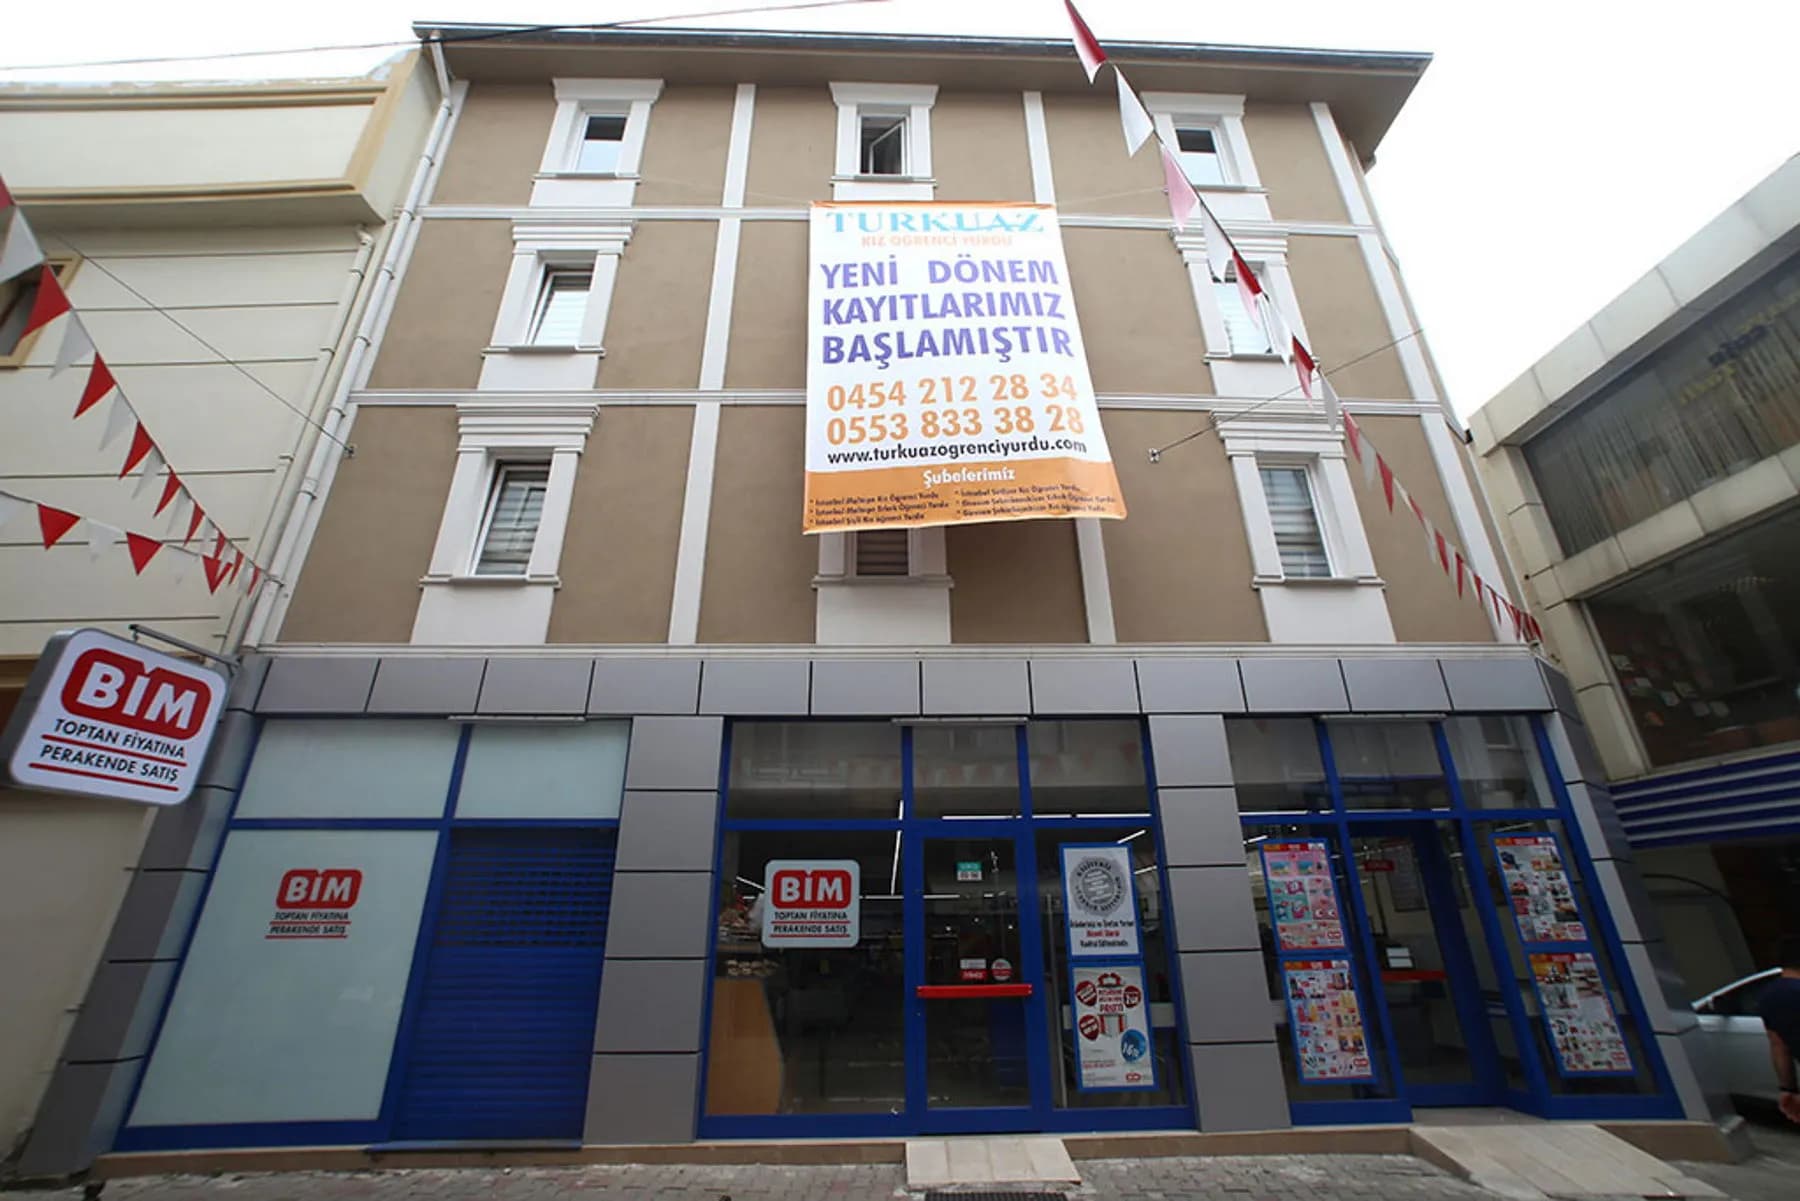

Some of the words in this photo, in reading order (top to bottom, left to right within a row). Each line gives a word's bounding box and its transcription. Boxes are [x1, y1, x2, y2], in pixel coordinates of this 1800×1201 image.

[827, 212, 1044, 233] TURKUAZ
[820, 254, 899, 289] YENİ
[927, 253, 1059, 285] DÖNEM
[823, 291, 1066, 325] KAYITLARIMIZ
[822, 326, 1075, 370] BAŞLAMIŞTIR
[827, 380, 907, 412] 0454
[918, 375, 978, 405] 212
[989, 373, 1031, 401] 28
[1040, 372, 1079, 400] 34
[827, 413, 909, 445] 0553
[920, 408, 983, 438] 833
[993, 406, 1035, 435] 38
[1044, 404, 1086, 435] 28
[827, 436, 1088, 464] www.turkuazogrenciyurdu.com
[923, 466, 1016, 488] Şubelerimiz
[54, 719, 120, 744] TOPTAN
[122, 732, 186, 759] FİYATINA
[40, 744, 137, 774] PERAKENDE
[140, 763, 179, 782] SATIŞ
[773, 925, 822, 933] PERAKENDE
[774, 911, 807, 920] TOPTAN
